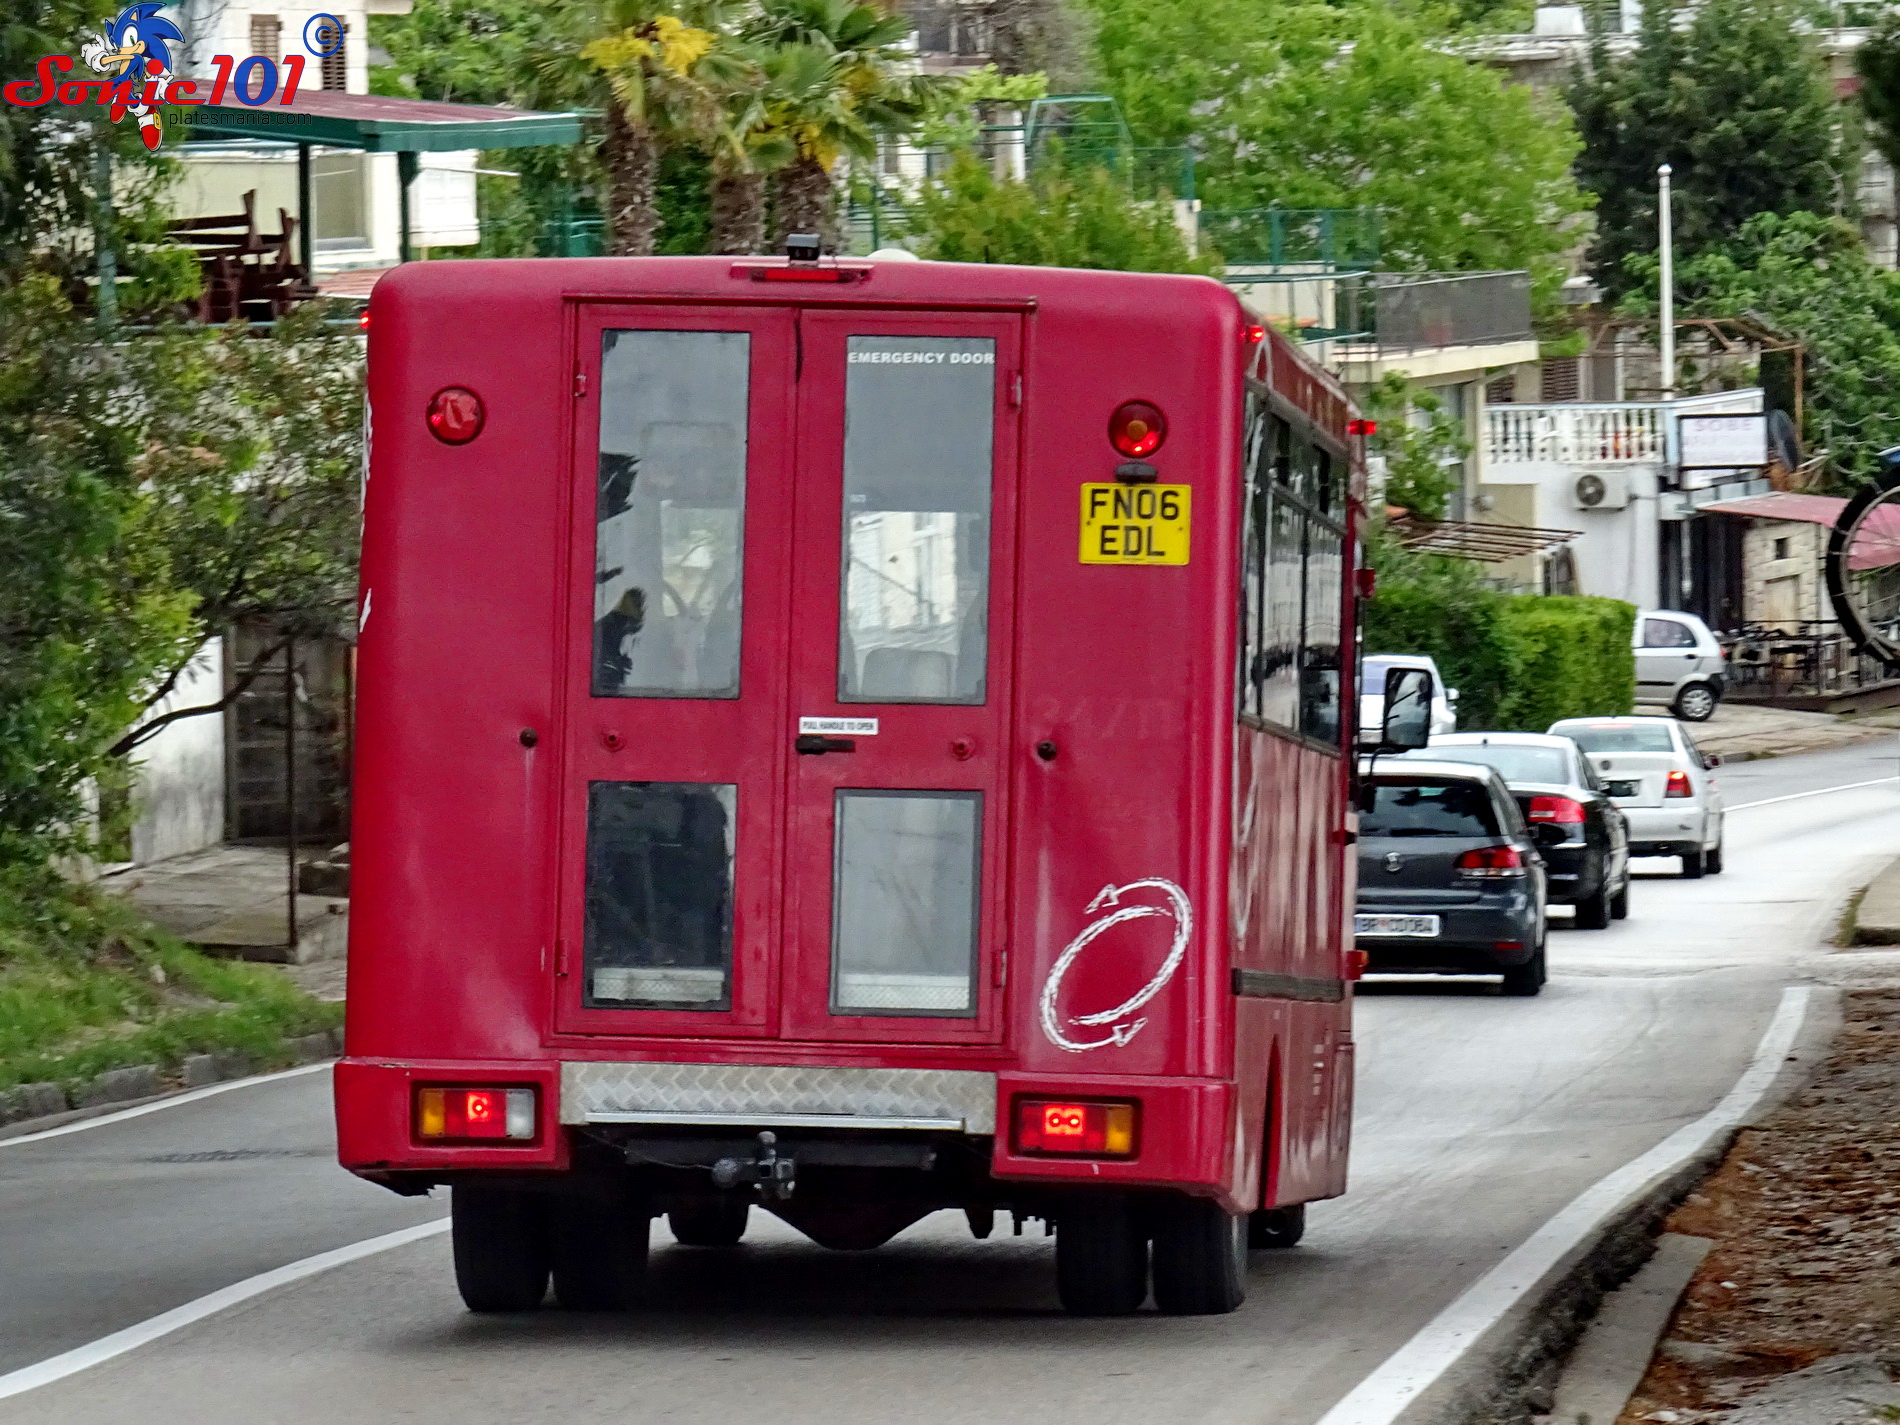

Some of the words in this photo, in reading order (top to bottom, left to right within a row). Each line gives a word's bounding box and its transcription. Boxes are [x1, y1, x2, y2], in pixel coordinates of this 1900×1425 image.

[848, 351, 946, 364] EMERGENCY
[949, 352, 995, 364] DOOR
[1089, 488, 1180, 521] FN06
[1099, 525, 1166, 557] EDL
